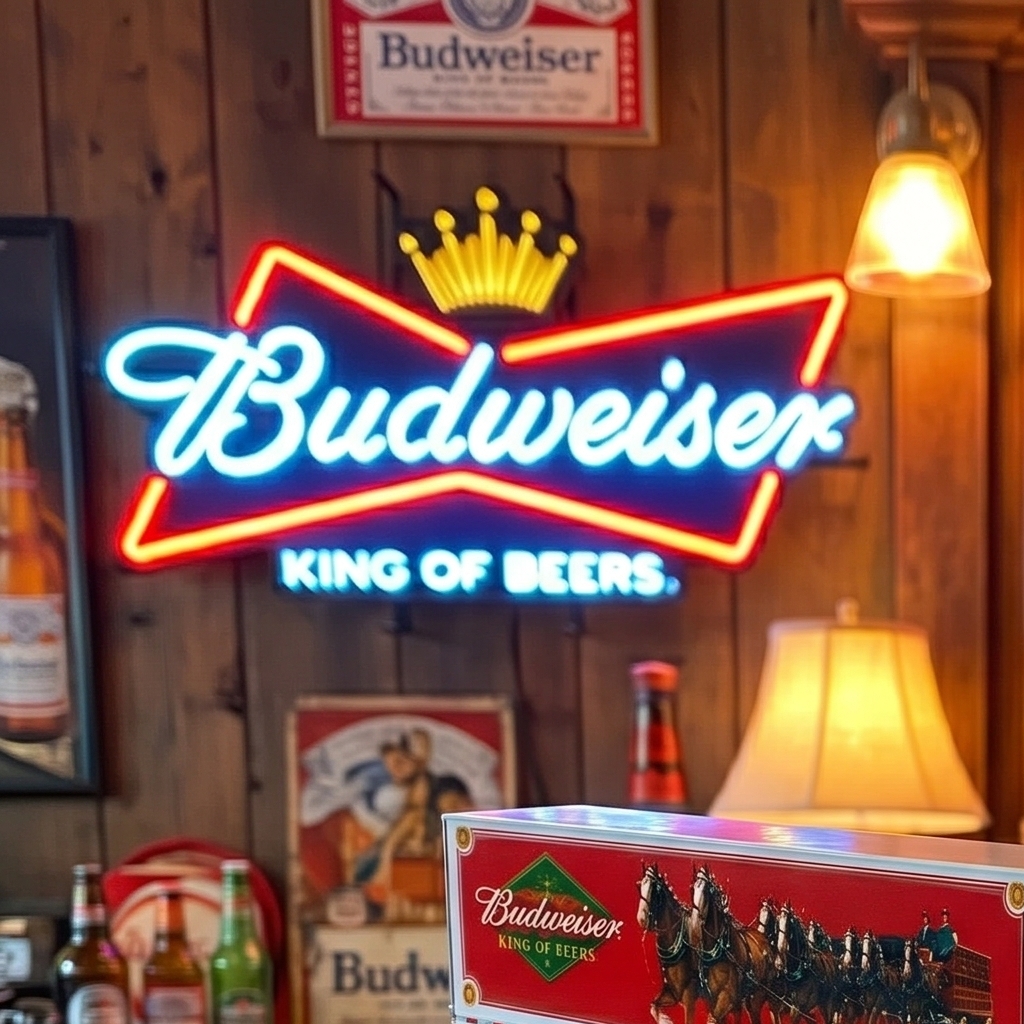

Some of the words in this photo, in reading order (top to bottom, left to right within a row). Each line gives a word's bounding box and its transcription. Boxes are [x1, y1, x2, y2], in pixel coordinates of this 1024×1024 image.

[378, 33, 600, 72] Budweiser
[104, 325, 855, 477] Budweiser
[280, 548, 410, 593] KING
[419, 549, 493, 593] OF
[498, 934, 531, 952] KING
[535, 940, 551, 955] OF
